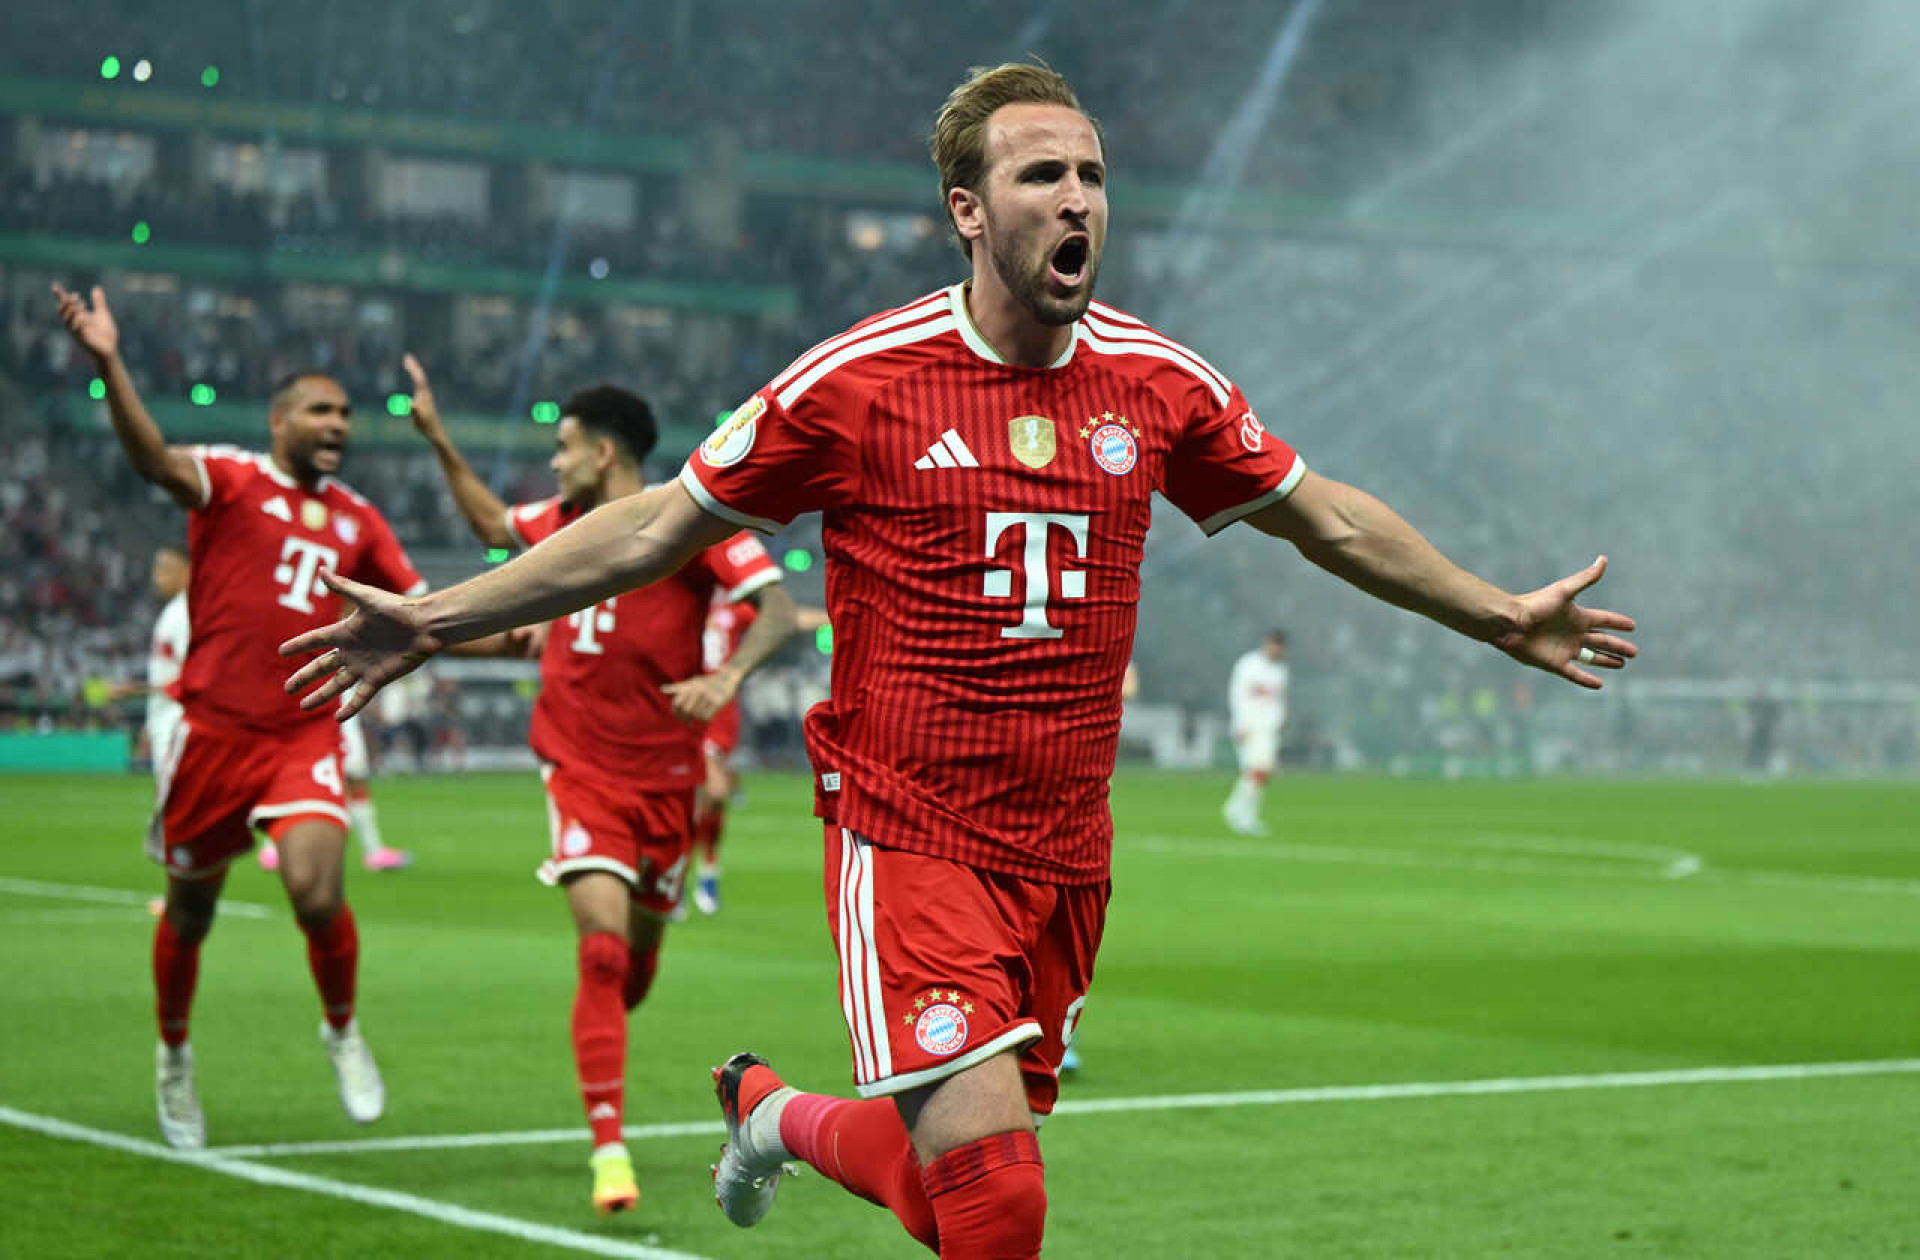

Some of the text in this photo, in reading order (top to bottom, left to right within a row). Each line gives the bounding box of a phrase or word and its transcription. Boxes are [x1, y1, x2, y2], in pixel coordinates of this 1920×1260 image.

[274, 535, 339, 614] T
[983, 512, 1089, 638] T
[312, 755, 342, 796] 4
